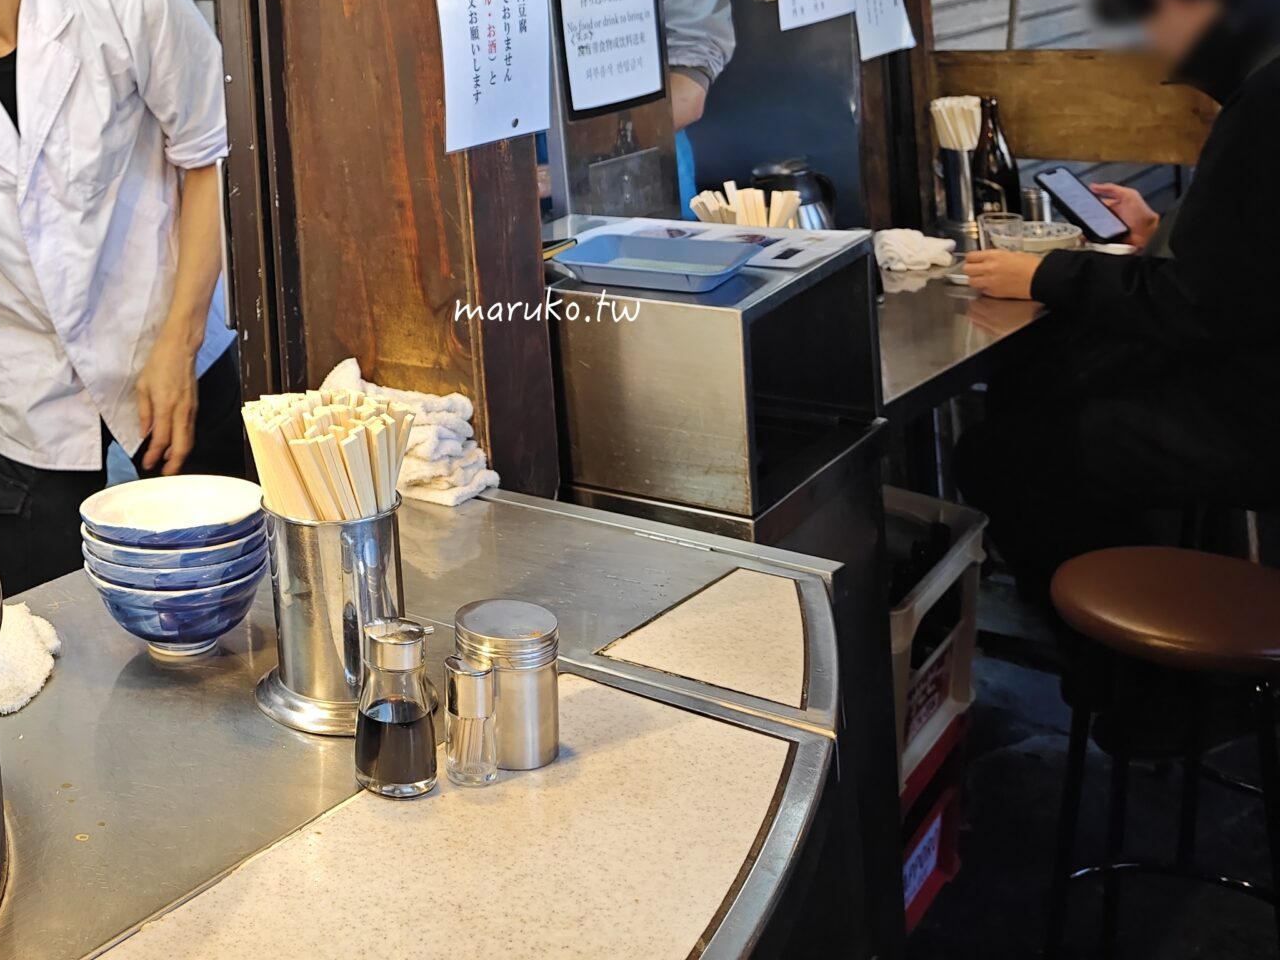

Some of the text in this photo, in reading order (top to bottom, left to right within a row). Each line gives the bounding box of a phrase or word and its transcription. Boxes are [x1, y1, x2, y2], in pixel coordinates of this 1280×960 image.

[567, 22, 578, 34] No
[578, 17, 594, 32] food
[593, 19, 602, 29] or
[602, 13, 620, 27] drink
[620, 13, 627, 23] to
[627, 10, 644, 24] bring
